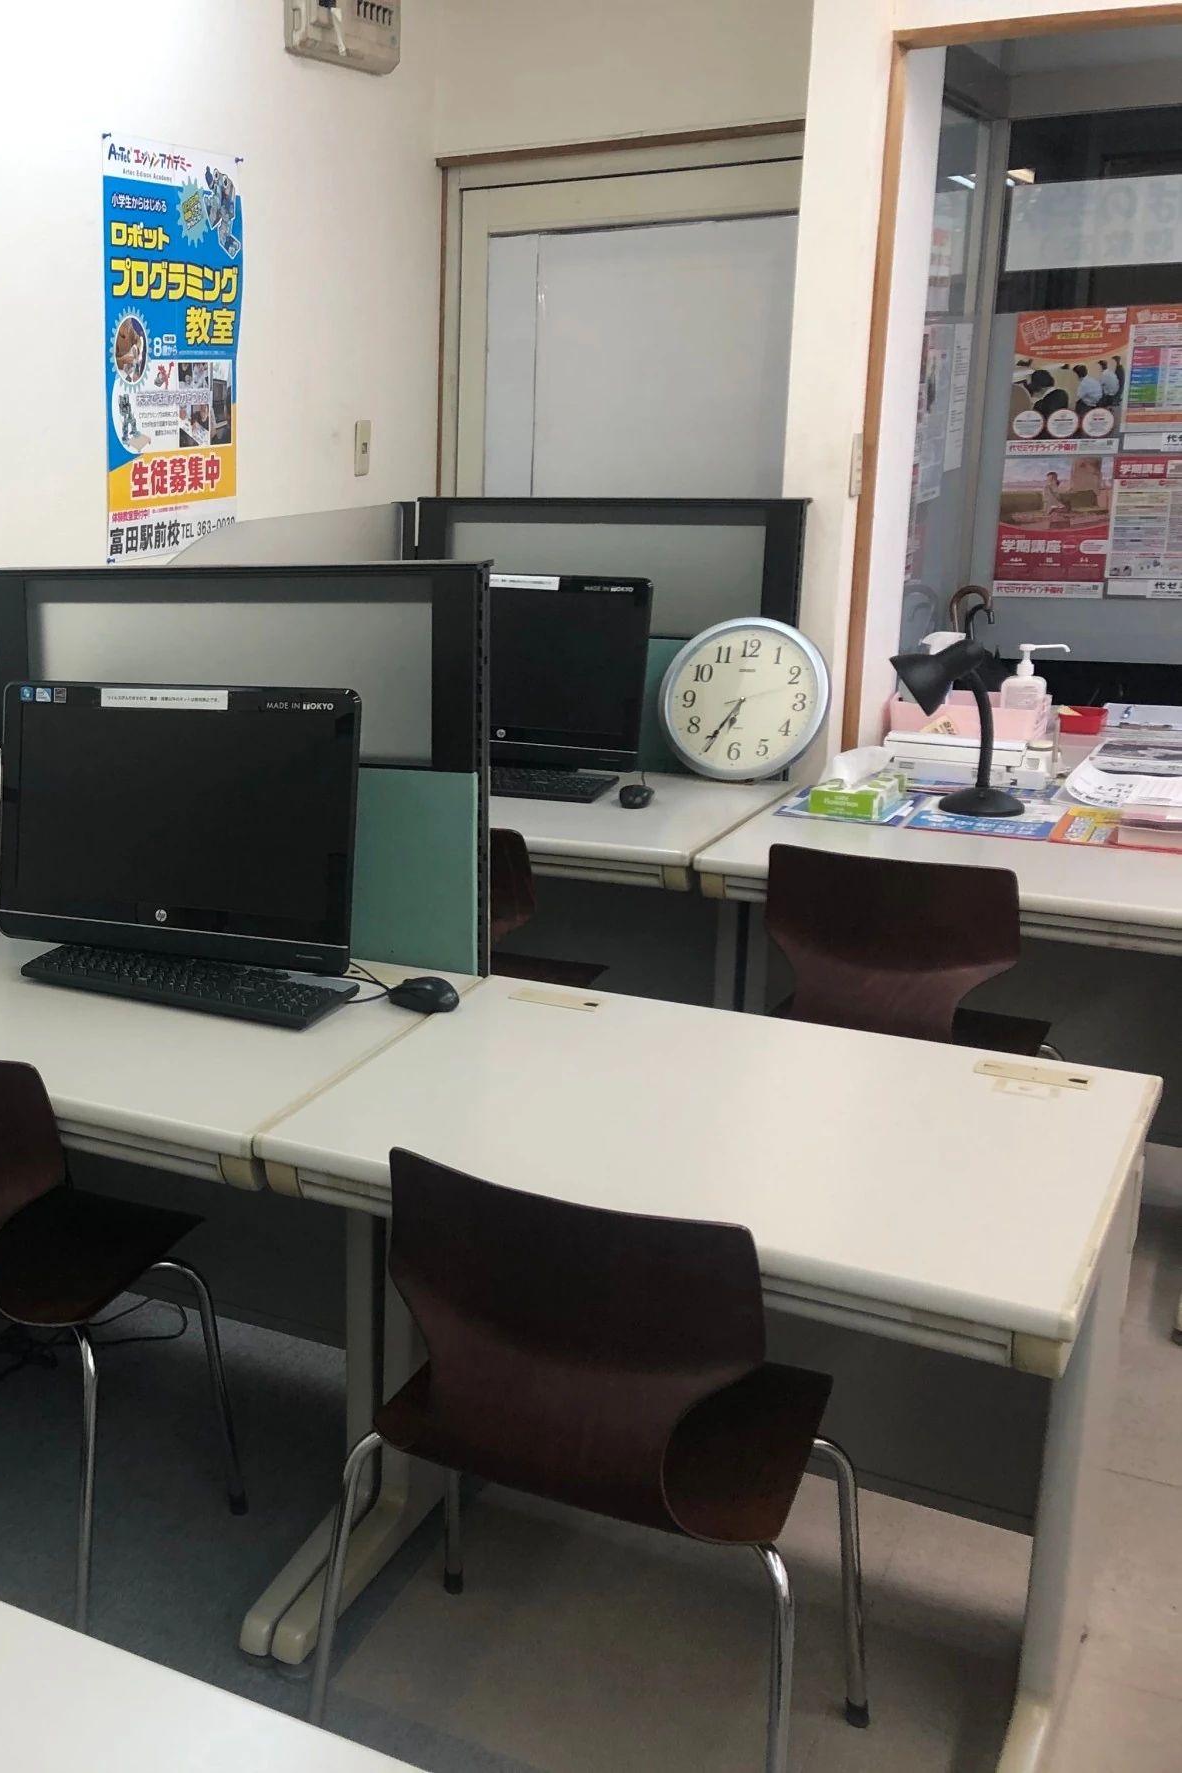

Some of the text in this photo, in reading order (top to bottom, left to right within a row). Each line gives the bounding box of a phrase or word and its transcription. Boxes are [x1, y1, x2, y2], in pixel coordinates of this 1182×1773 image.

[111, 193, 168, 213] 小学生からはじめる
[110, 222, 170, 251] ロボット
[110, 257, 239, 304] プログラミング
[186, 306, 237, 347] 教室
[130, 454, 222, 499] 生徒募集中
[109, 520, 180, 556] 富田駅前校
[181, 523, 195, 540] TEL
[715, 645, 732, 664] 11
[740, 639, 761, 658] 12
[773, 646, 783, 665] 1
[693, 663, 714, 683] 10
[787, 665, 802, 685] 2
[266, 702, 334, 711] MADE IN TOKYO
[682, 690, 696, 708] 9
[792, 692, 807, 712] 3
[687, 715, 701, 734] 8
[778, 718, 791, 737] 4
[727, 741, 742, 760] 6
[756, 738, 769, 757] 5
